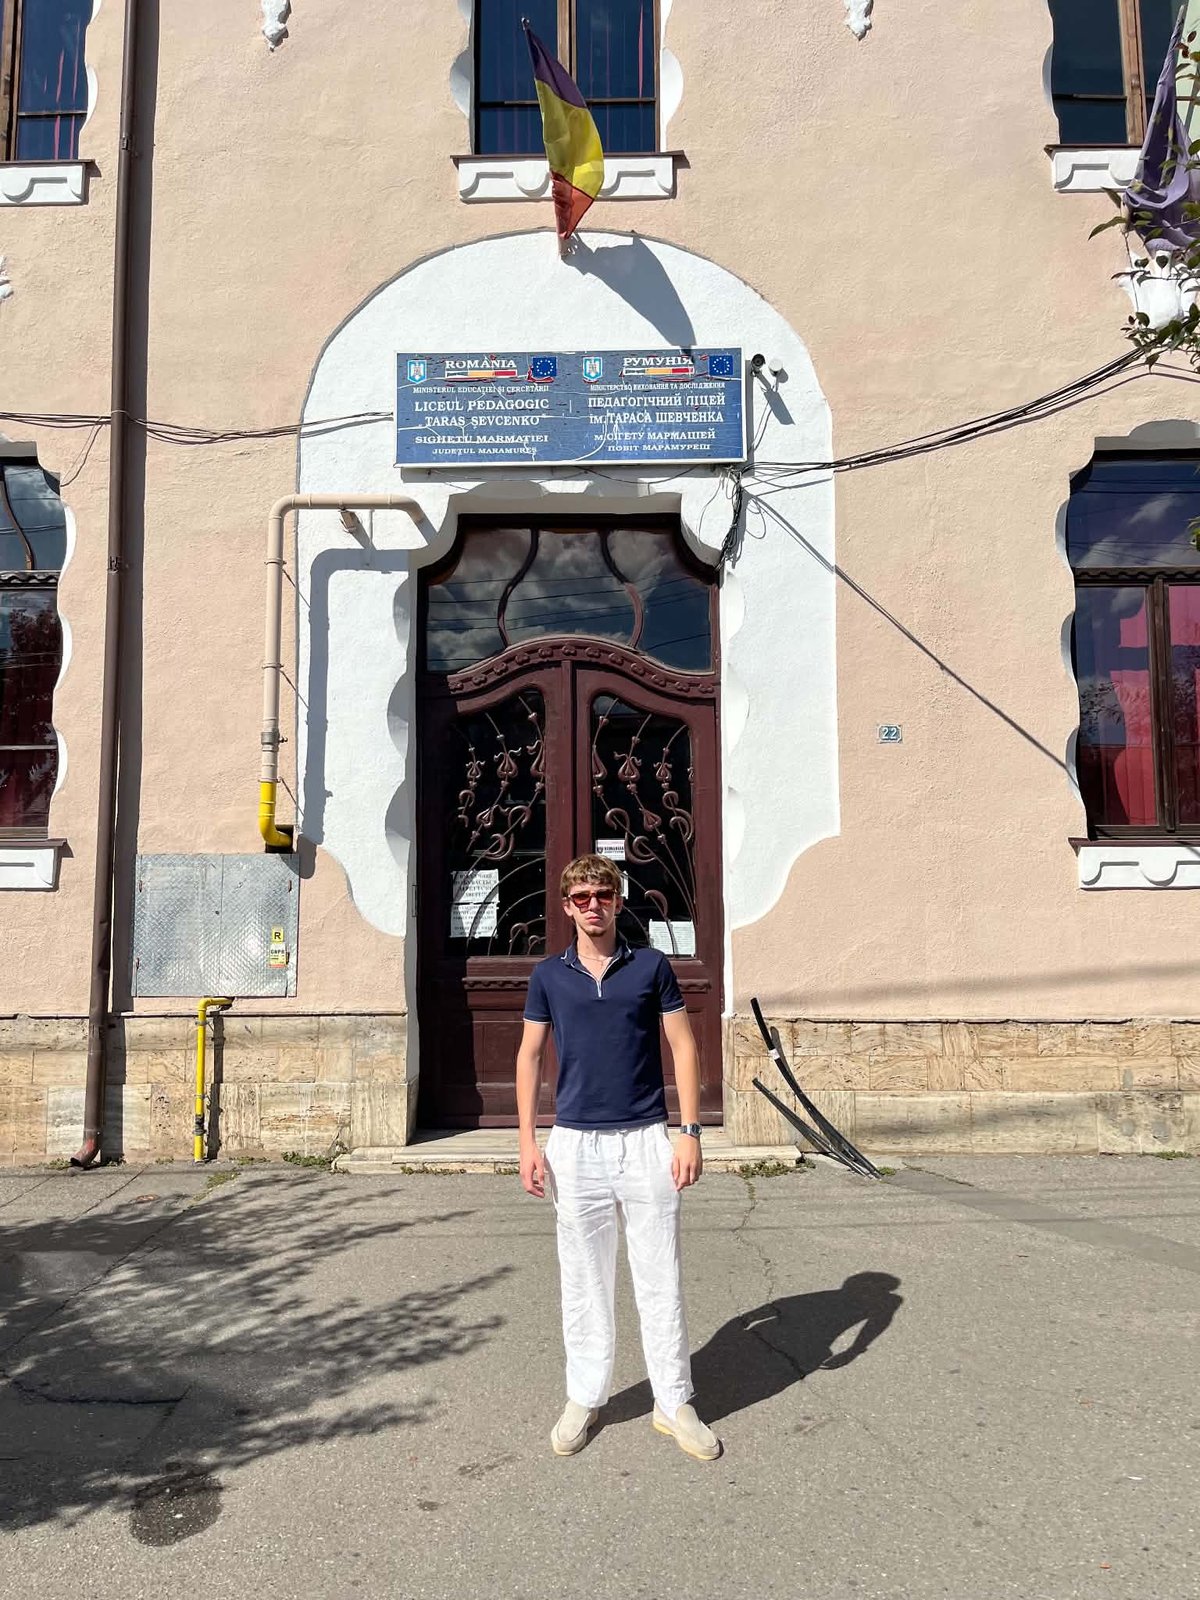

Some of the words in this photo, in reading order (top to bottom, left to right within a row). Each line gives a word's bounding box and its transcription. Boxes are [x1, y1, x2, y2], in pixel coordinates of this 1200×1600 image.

[445, 357, 517, 369] ROMÂNIA
[623, 356, 694, 367] РУМУНІЯ
[413, 386, 456, 394] MINISTERUL
[415, 400, 464, 411] LICEUL
[468, 398, 550, 411] PEDAGOGIC
[588, 393, 682, 408] ПЕДАГОГІЧНИЙ
[686, 392, 726, 407] ЛІЦЕЙ
[655, 411, 724, 423] ШЕВЧЕНКА
[415, 435, 473, 444] SIGHETU
[608, 444, 640, 452] ПОВІТ
[642, 443, 711, 451] МАРАМУРЕШ
[882, 726, 897, 739] 22
[274, 931, 282, 940] R
